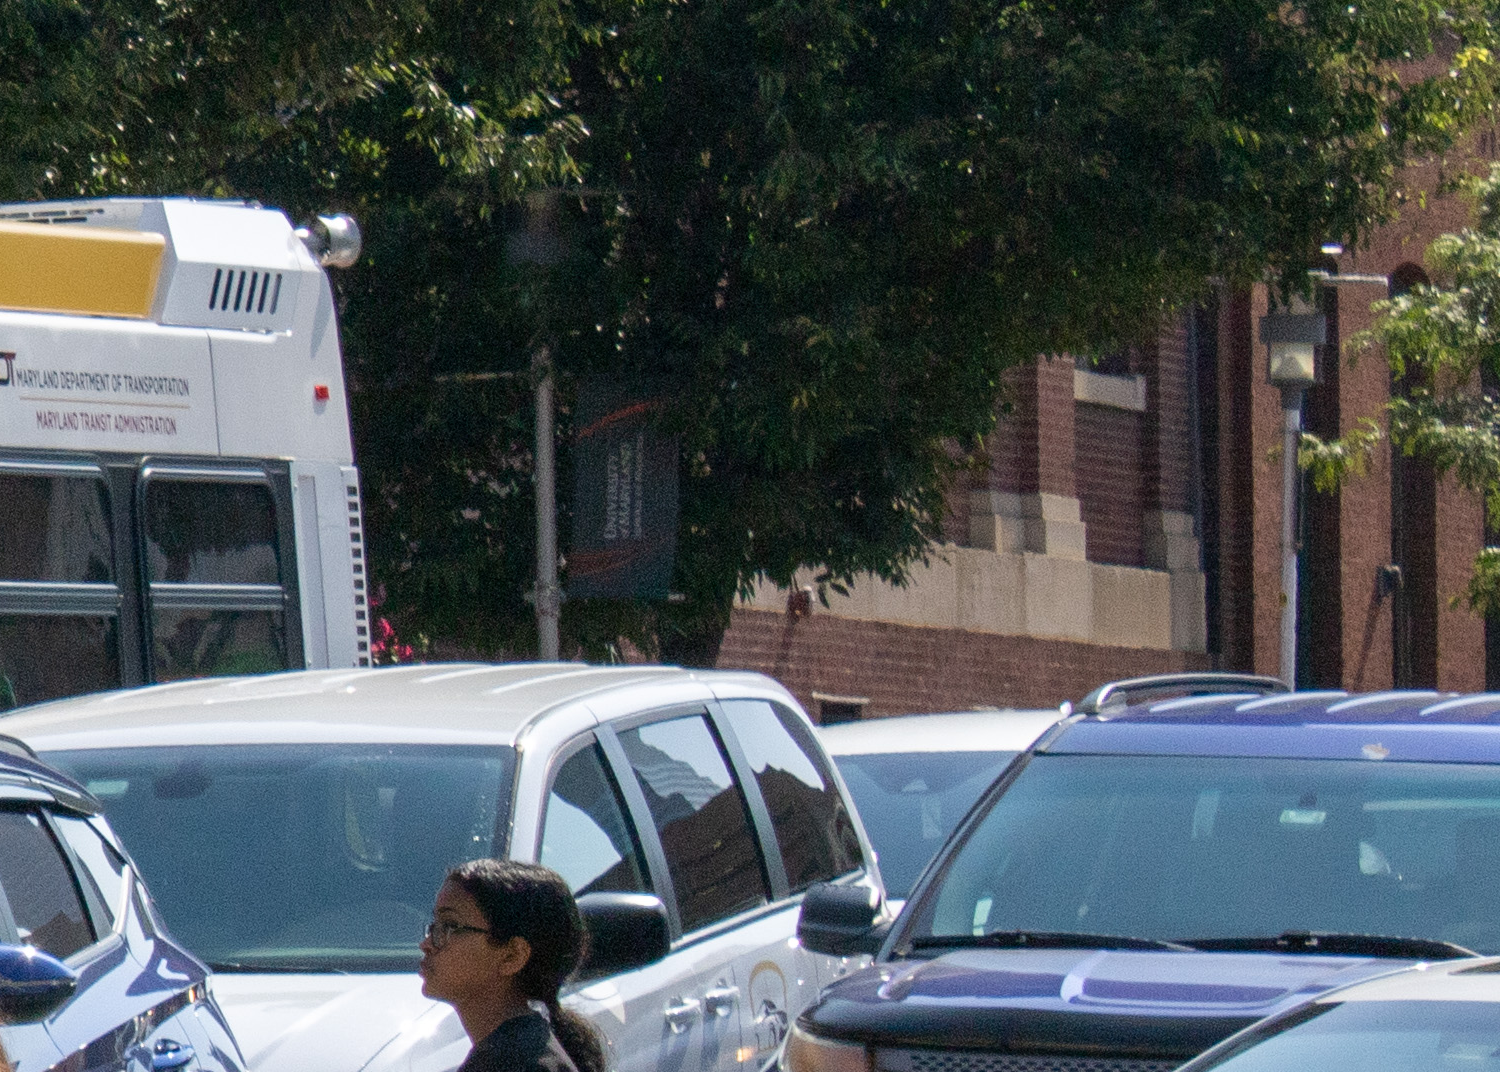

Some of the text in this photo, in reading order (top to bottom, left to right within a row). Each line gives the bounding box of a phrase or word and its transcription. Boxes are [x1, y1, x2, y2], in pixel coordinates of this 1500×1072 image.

[16, 368, 191, 397] MARYLAND DEPARTMENT OF TRANSPORTATION
[35, 410, 177, 436] MARYLAND TRANSIT ADMINISTRATION
